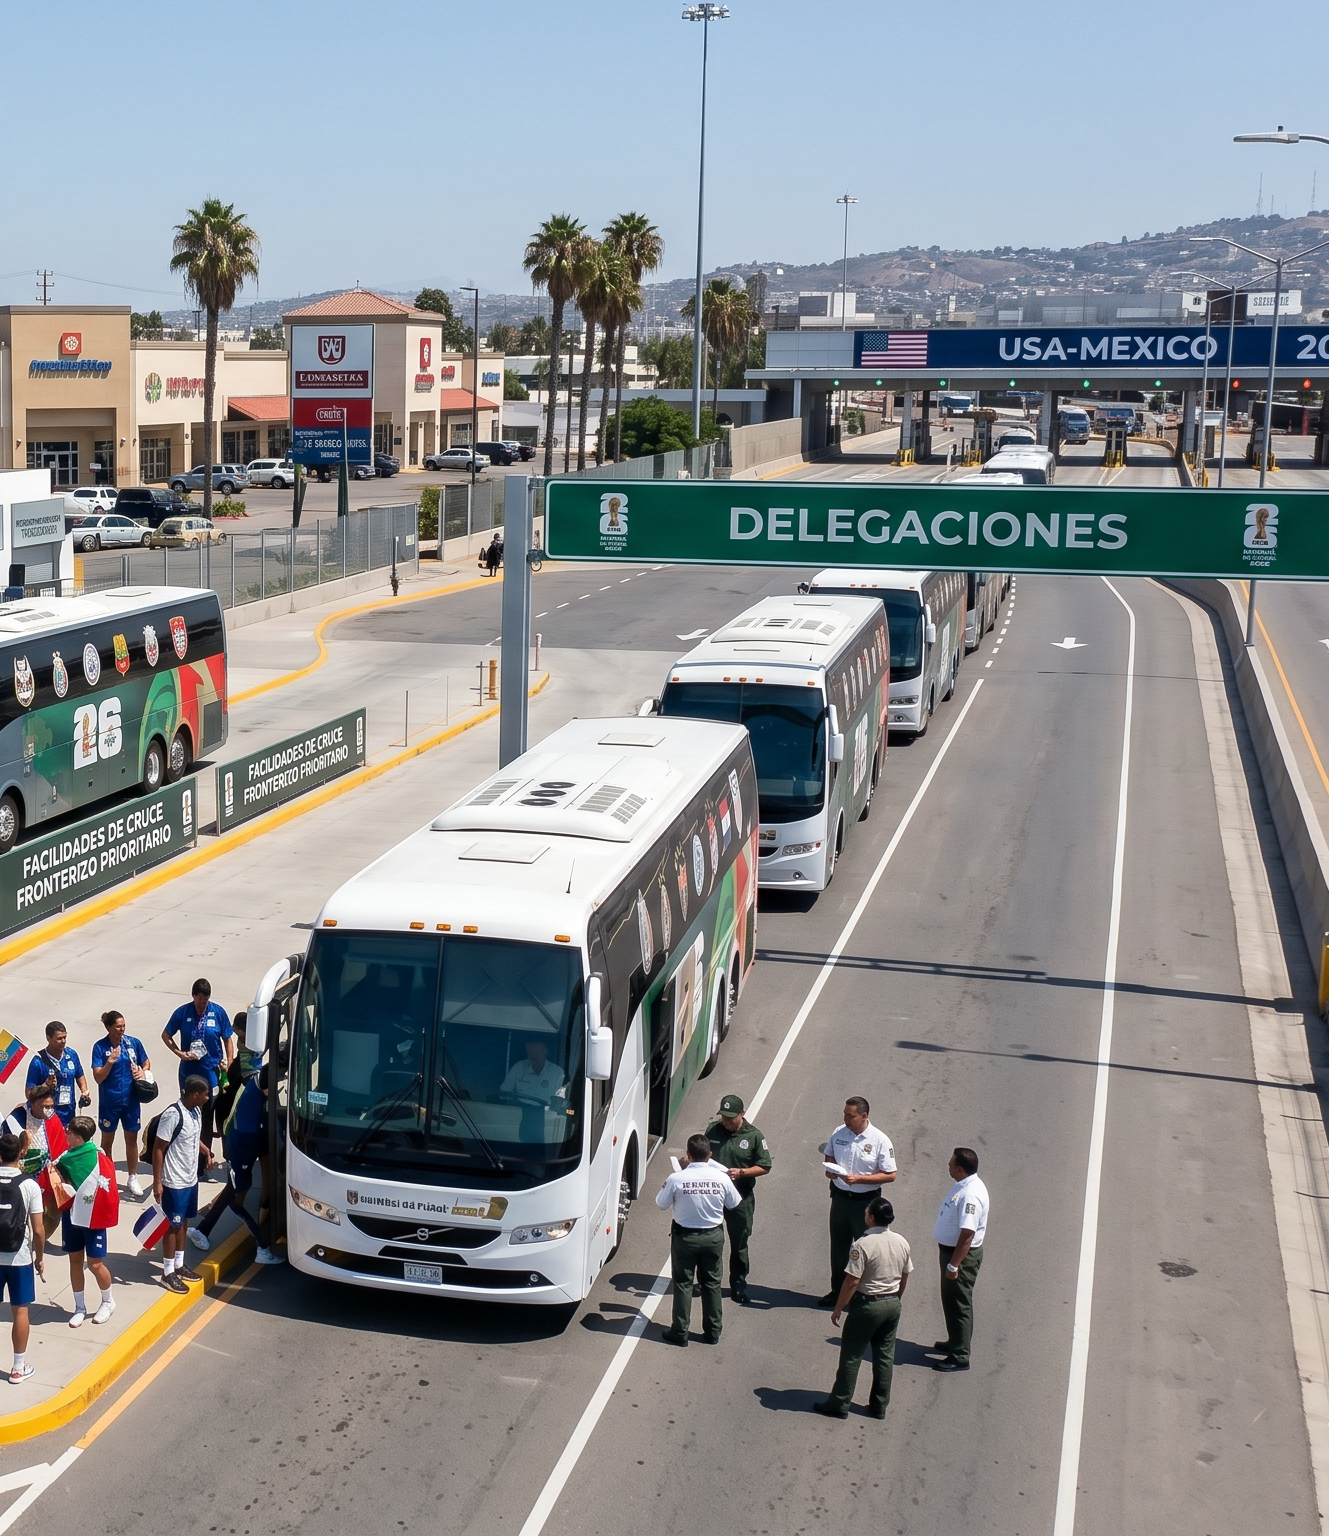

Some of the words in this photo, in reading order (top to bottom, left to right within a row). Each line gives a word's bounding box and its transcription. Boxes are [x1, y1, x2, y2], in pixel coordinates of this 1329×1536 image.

[999, 335, 1218, 361] USA-MEXICO
[729, 506, 1128, 550] DELEGACIONES
[248, 743, 304, 782] FACILIDADES
[305, 737, 317, 757] DE
[317, 726, 343, 751] CRUCE
[300, 744, 349, 780] PRIORITARIO
[23, 829, 105, 880] FACILIDADES
[108, 822, 124, 844] DE
[126, 801, 164, 834] CRUCE
[16, 855, 98, 911] FRONTERIZO
[100, 823, 172, 873] PRIORITARIO
